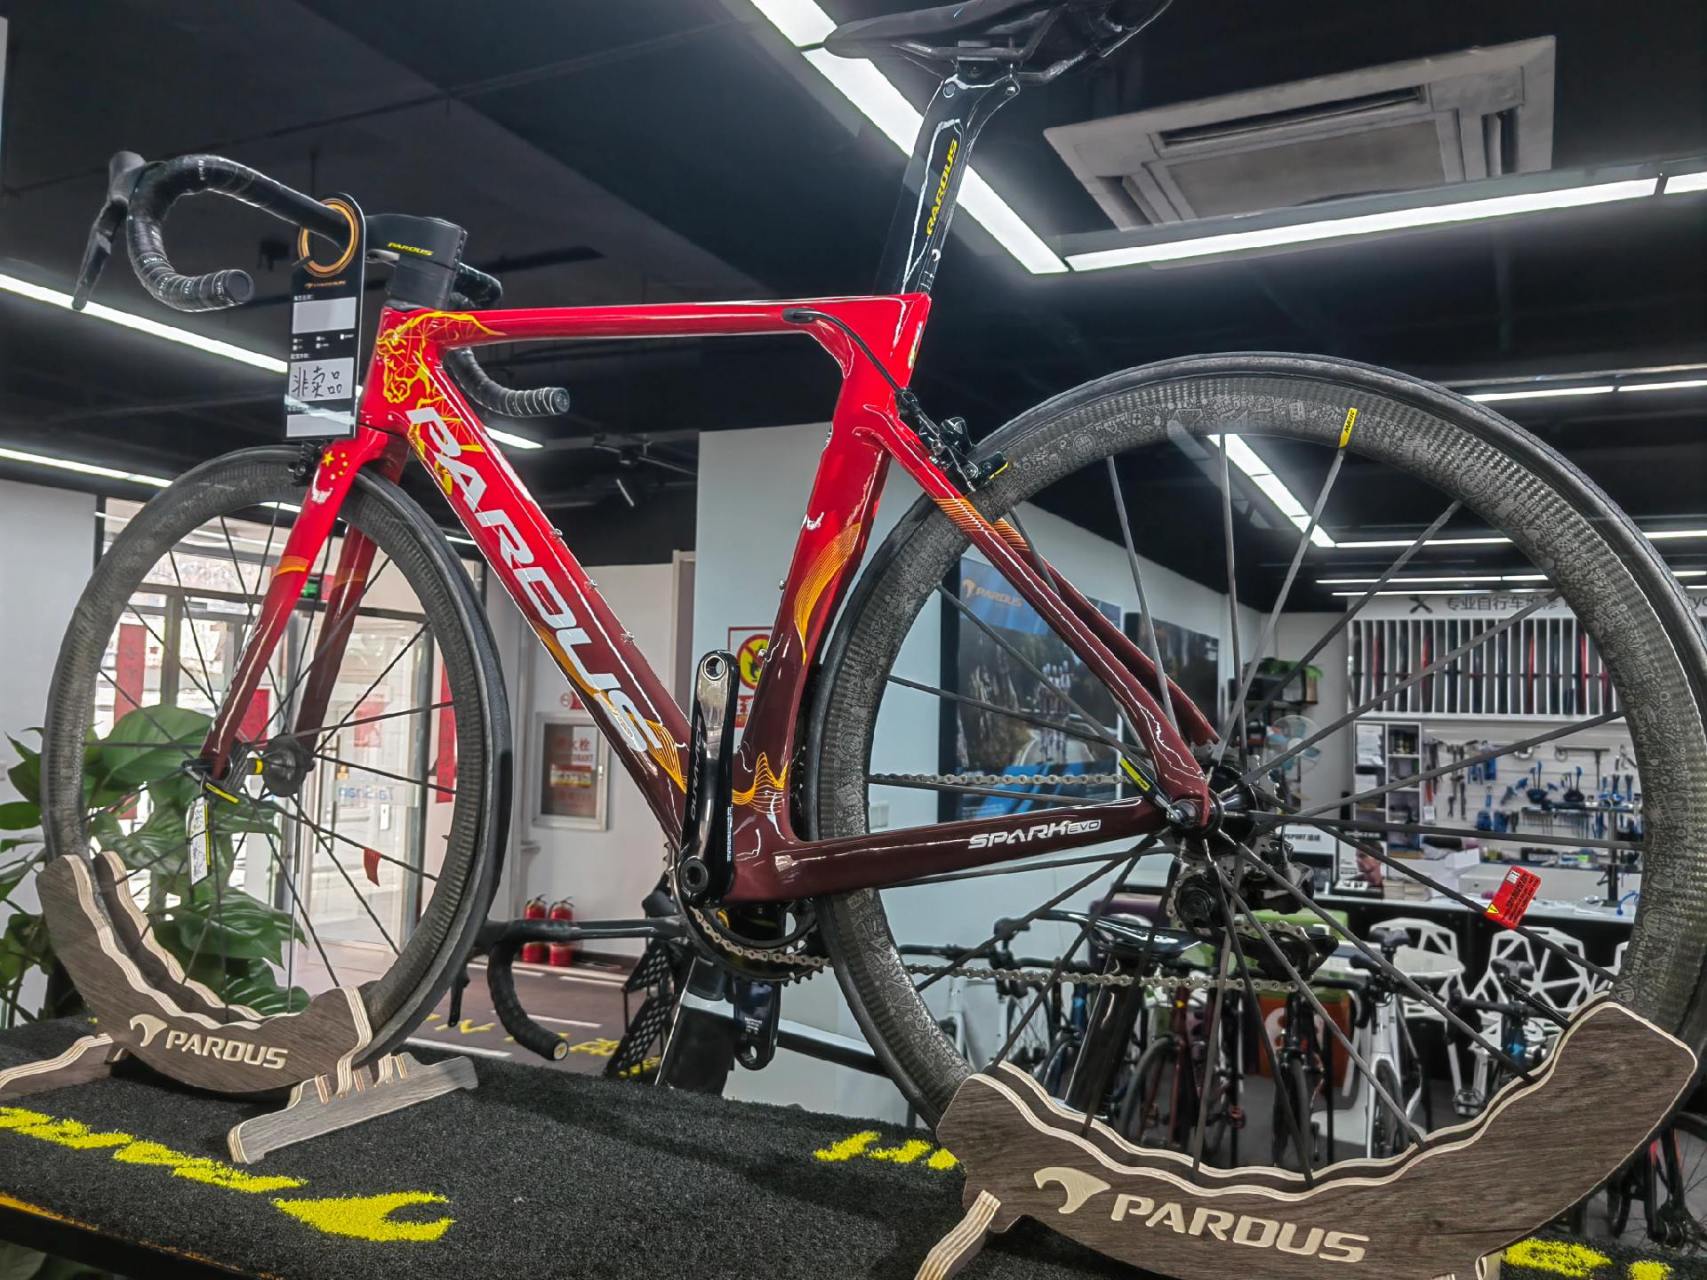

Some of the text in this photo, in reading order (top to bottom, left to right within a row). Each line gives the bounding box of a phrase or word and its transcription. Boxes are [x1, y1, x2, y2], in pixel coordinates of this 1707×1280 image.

[926, 138, 958, 236] PARDUS
[406, 406, 662, 752] PARDUS
[968, 820, 1070, 850] SPARK
[166, 1030, 289, 1070] PARDUS
[1110, 1193, 1370, 1263] PARDUS
